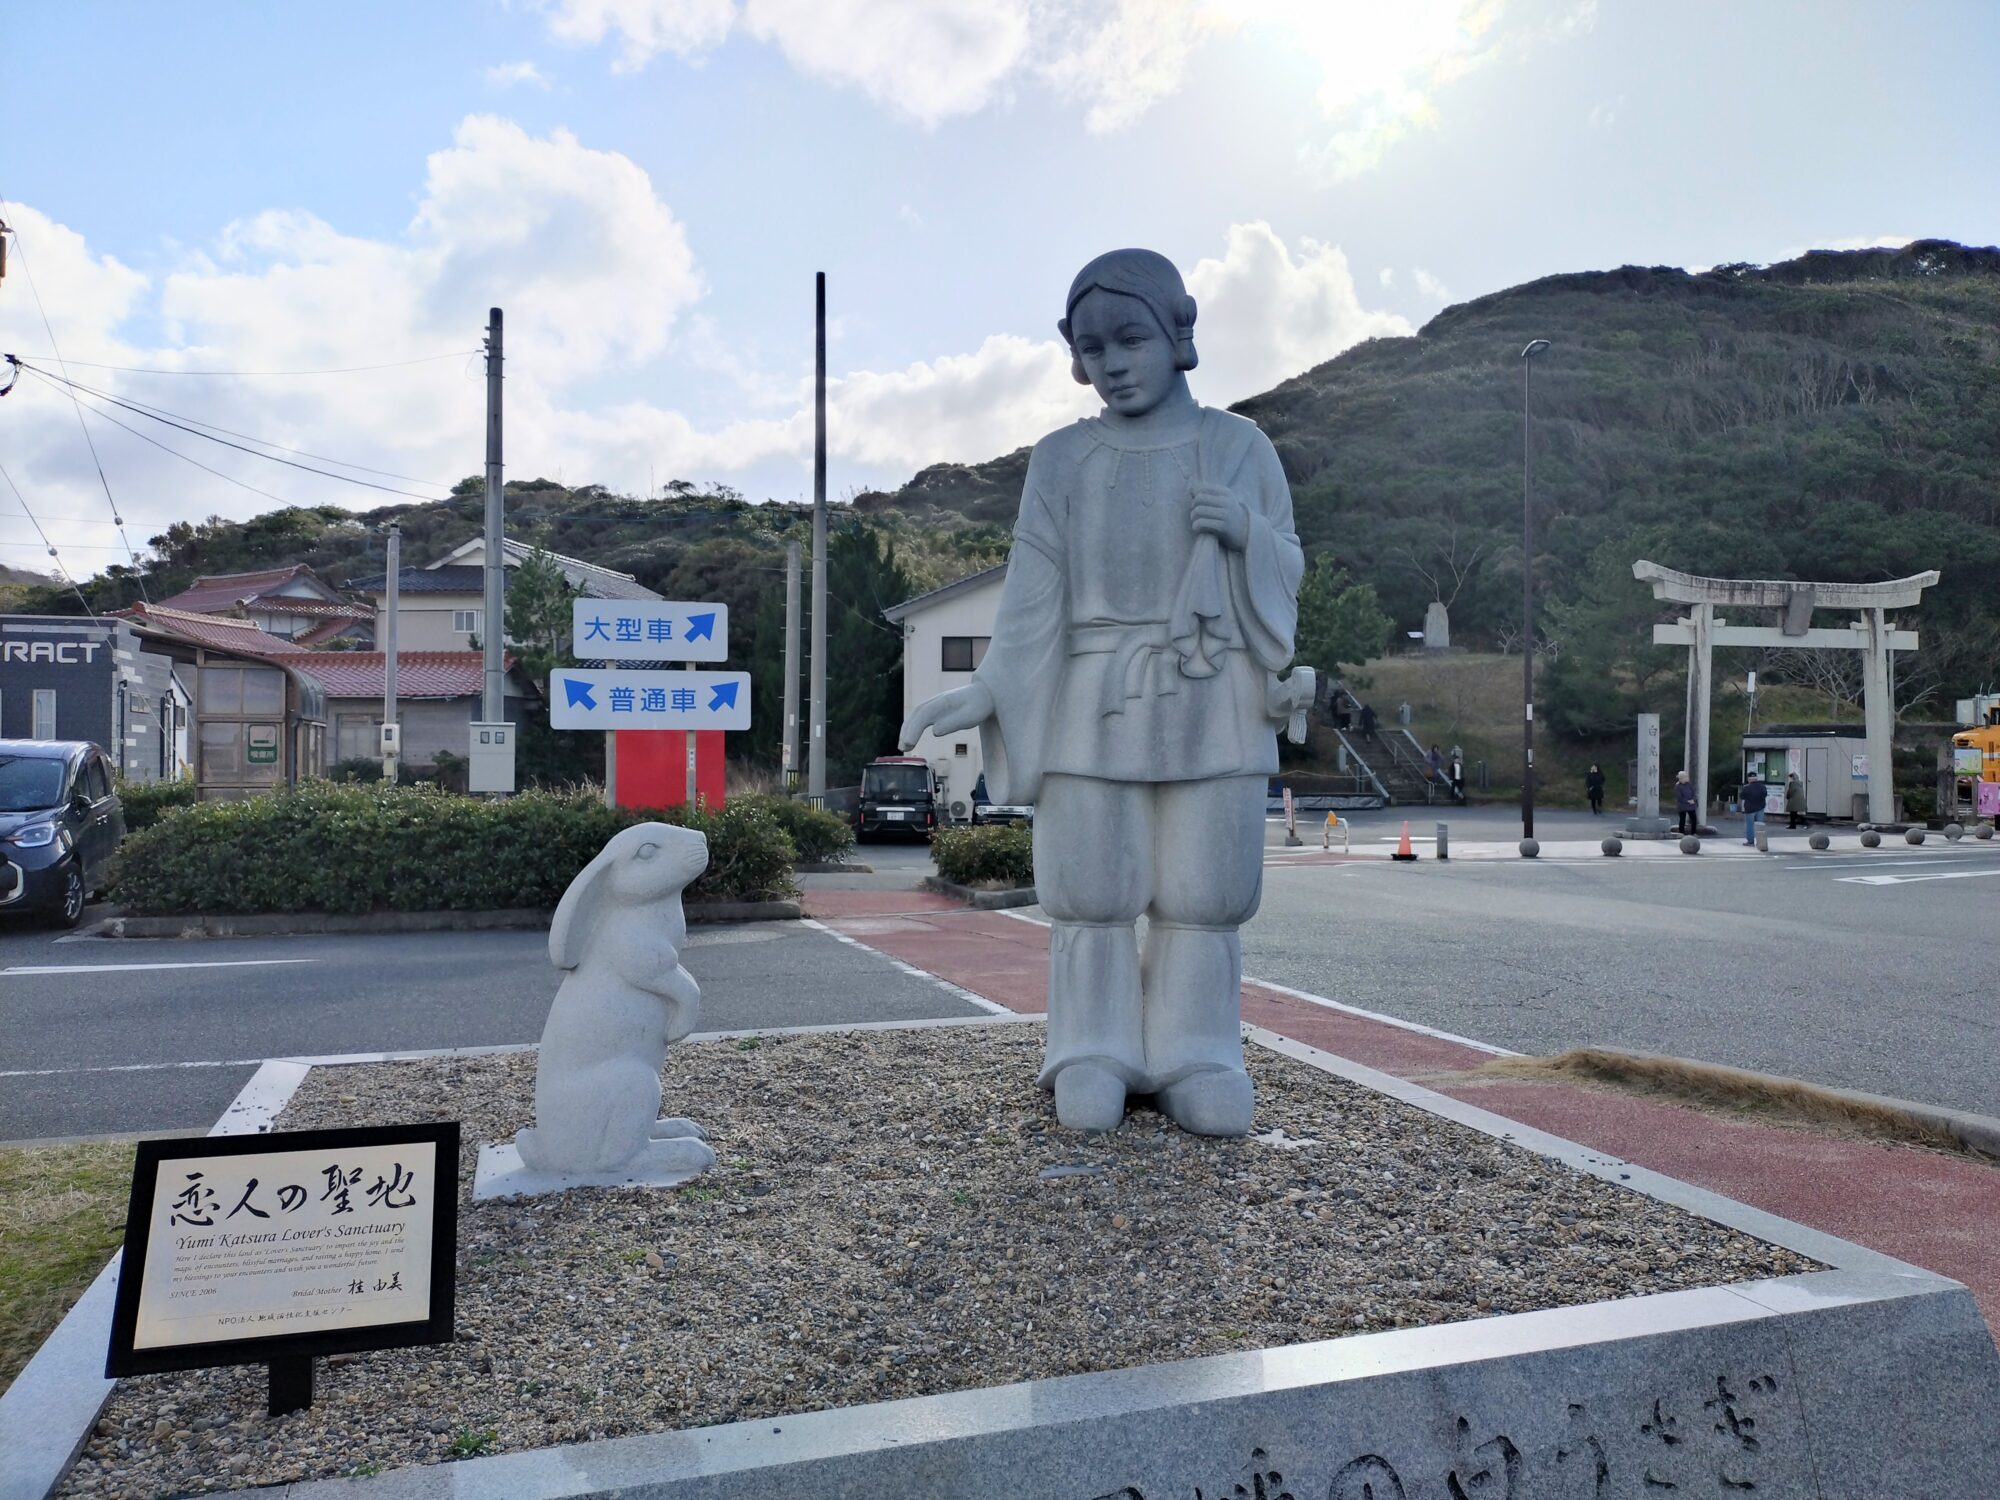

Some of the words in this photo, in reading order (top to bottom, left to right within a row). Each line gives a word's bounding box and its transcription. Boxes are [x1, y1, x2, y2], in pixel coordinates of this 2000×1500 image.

[584, 616, 673, 643] 大型車
[0, 641, 101, 663] RACT
[609, 687, 697, 713] 普通車
[170, 1162, 416, 1227] 恋人の聖地
[176, 1234, 215, 1249] Yumi
[219, 1232, 277, 1248] Katsura
[281, 1226, 332, 1241] Lover's
[334, 1221, 406, 1238] Sanctuary
[223, 1250, 236, 1258] this
[238, 1249, 253, 1257] land
[344, 1250, 364, 1260] happy
[184, 1272, 213, 1281] blessings
[222, 1271, 239, 1280] your
[238, 1268, 273, 1276] encounters
[273, 1266, 286, 1274] and
[304, 1264, 316, 1273] you
[323, 1260, 356, 1270] wonderful
[169, 1289, 197, 1299] SINCE
[198, 1287, 217, 1296] 2006
[292, 1288, 314, 1298] Bridal
[315, 1287, 342, 1296] Mother
[347, 1278, 364, 1295] 桂
[372, 1271, 402, 1292] 由美
